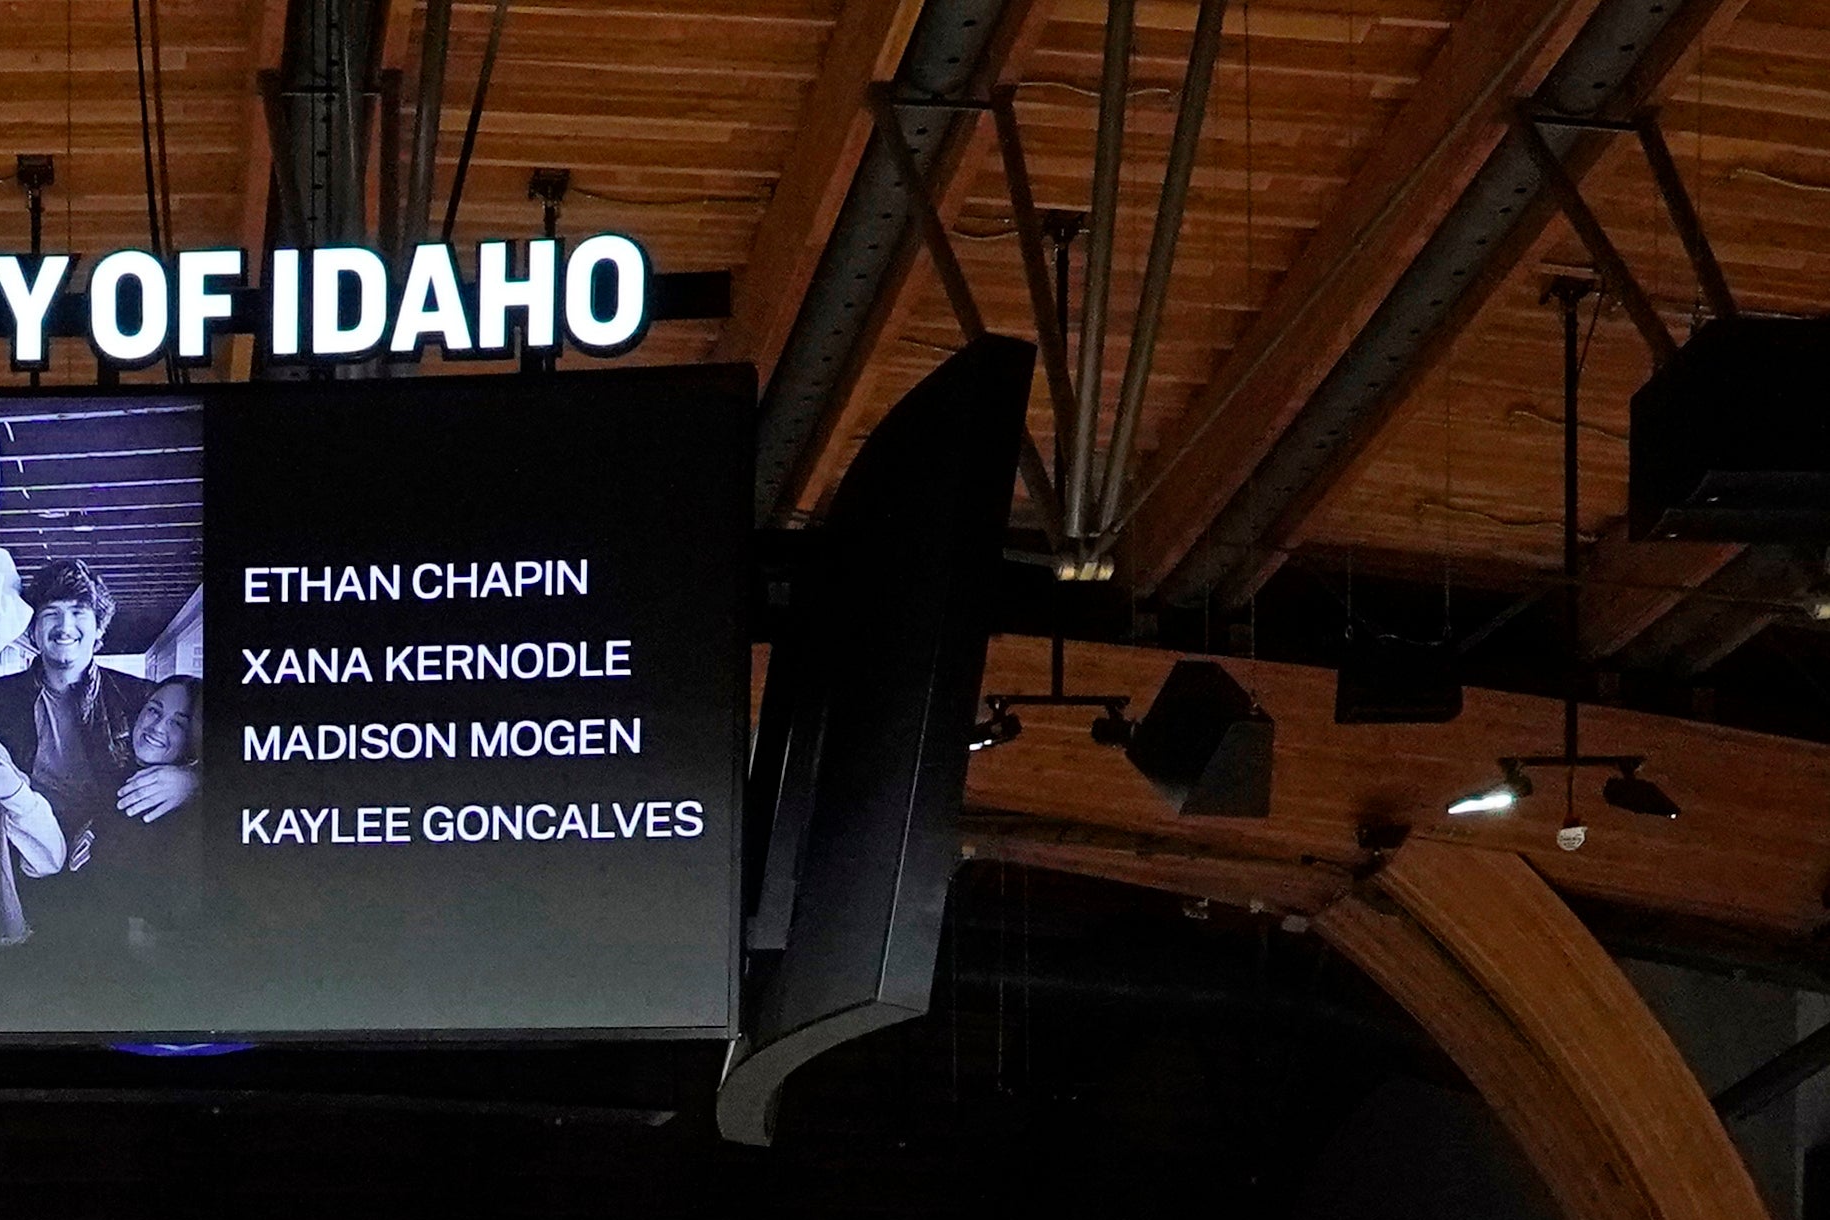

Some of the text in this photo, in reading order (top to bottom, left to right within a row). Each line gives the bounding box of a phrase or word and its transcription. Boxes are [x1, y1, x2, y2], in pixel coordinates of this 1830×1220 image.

[89, 250, 242, 360] OF
[271, 235, 644, 357] IDAHO
[244, 558, 588, 604] ETHAN CHAPIN
[241, 639, 632, 685] XANA KERNODLE
[244, 716, 641, 762] MADISON MOGEN
[242, 800, 704, 845] KAYLEE GONCALVES
